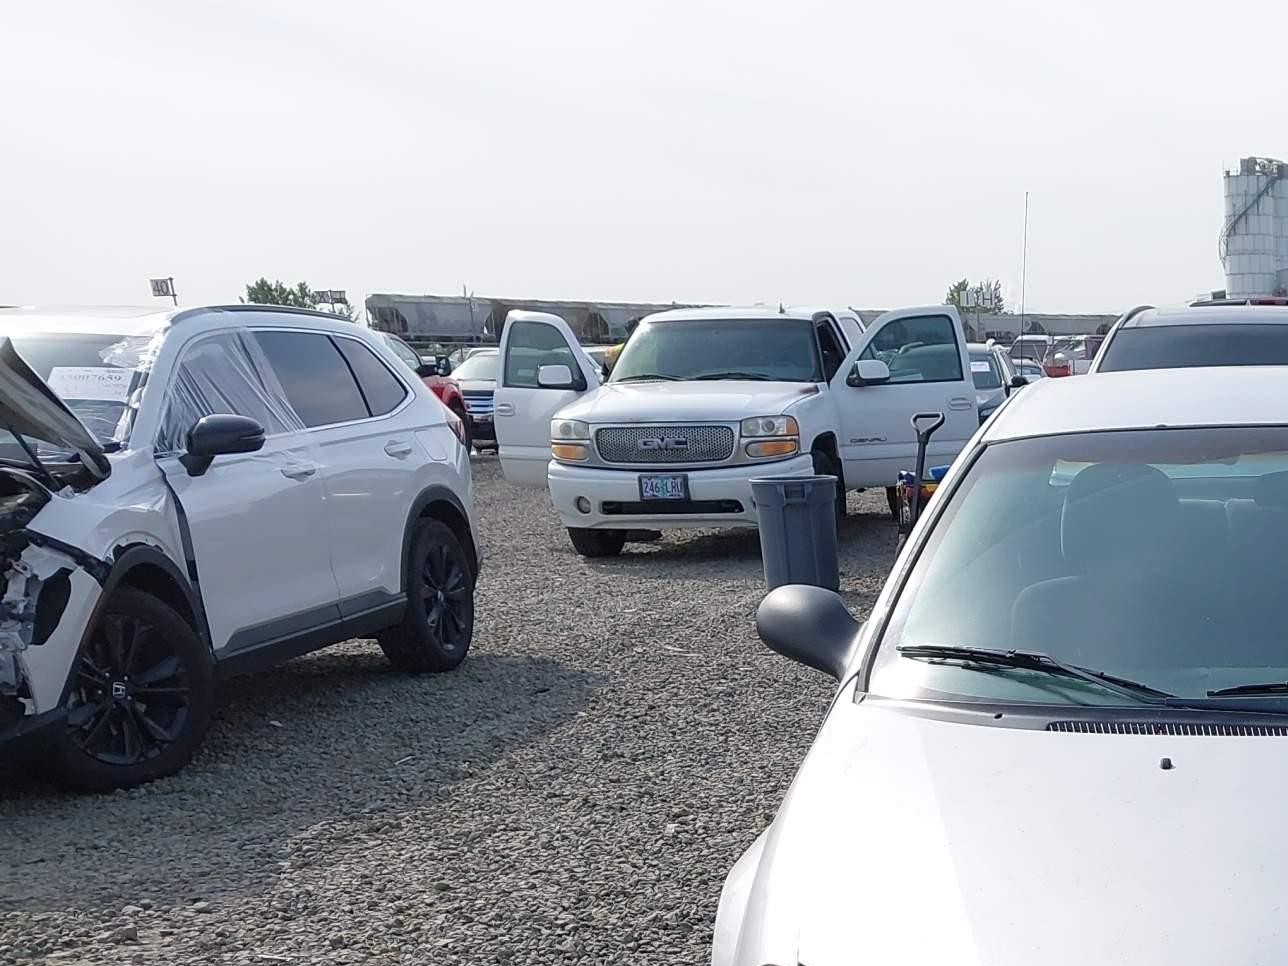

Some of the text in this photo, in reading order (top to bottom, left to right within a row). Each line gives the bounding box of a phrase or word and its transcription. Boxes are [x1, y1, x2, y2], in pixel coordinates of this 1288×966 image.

[152, 280, 169, 295] 40
[638, 438, 687, 450] GMC
[643, 481, 660, 493] 246
